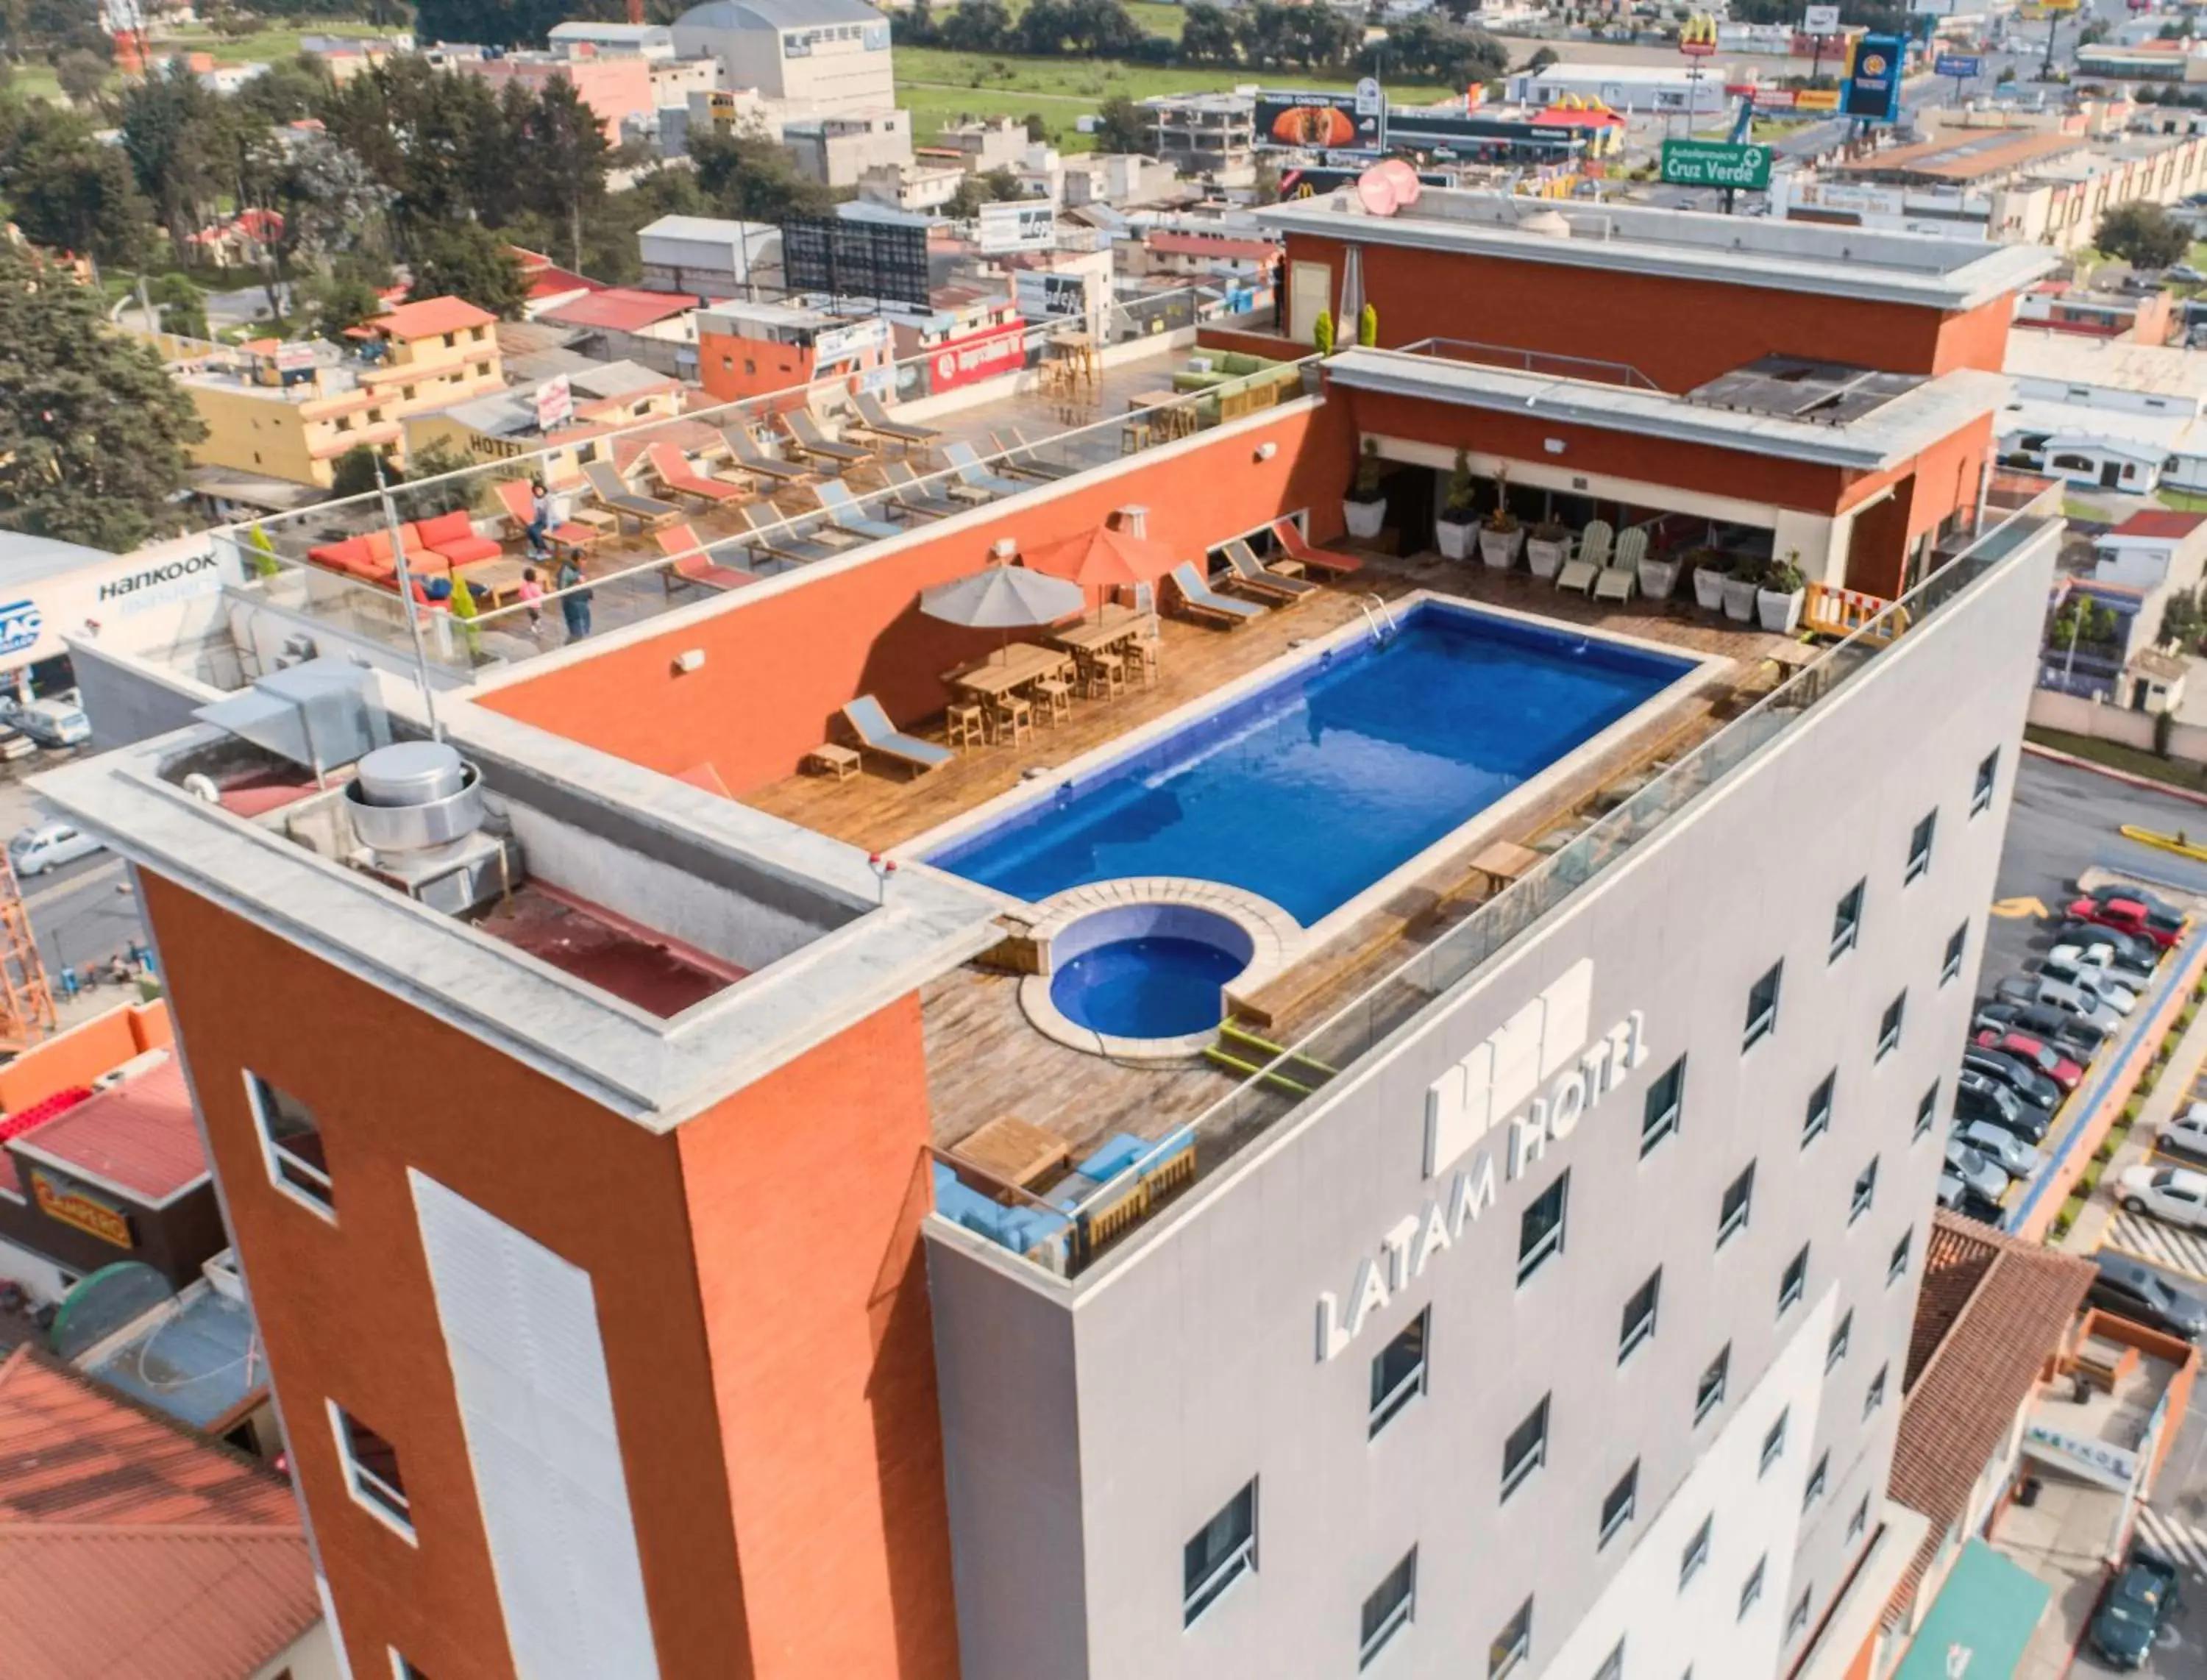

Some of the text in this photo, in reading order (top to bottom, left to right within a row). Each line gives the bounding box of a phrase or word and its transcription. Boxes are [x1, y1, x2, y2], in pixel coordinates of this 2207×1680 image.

[1669, 146, 1738, 161] Autofarmacia
[1668, 158, 1755, 183] Cruz Verde
[1315, 1008, 1649, 1363] LATAM HOTEL
